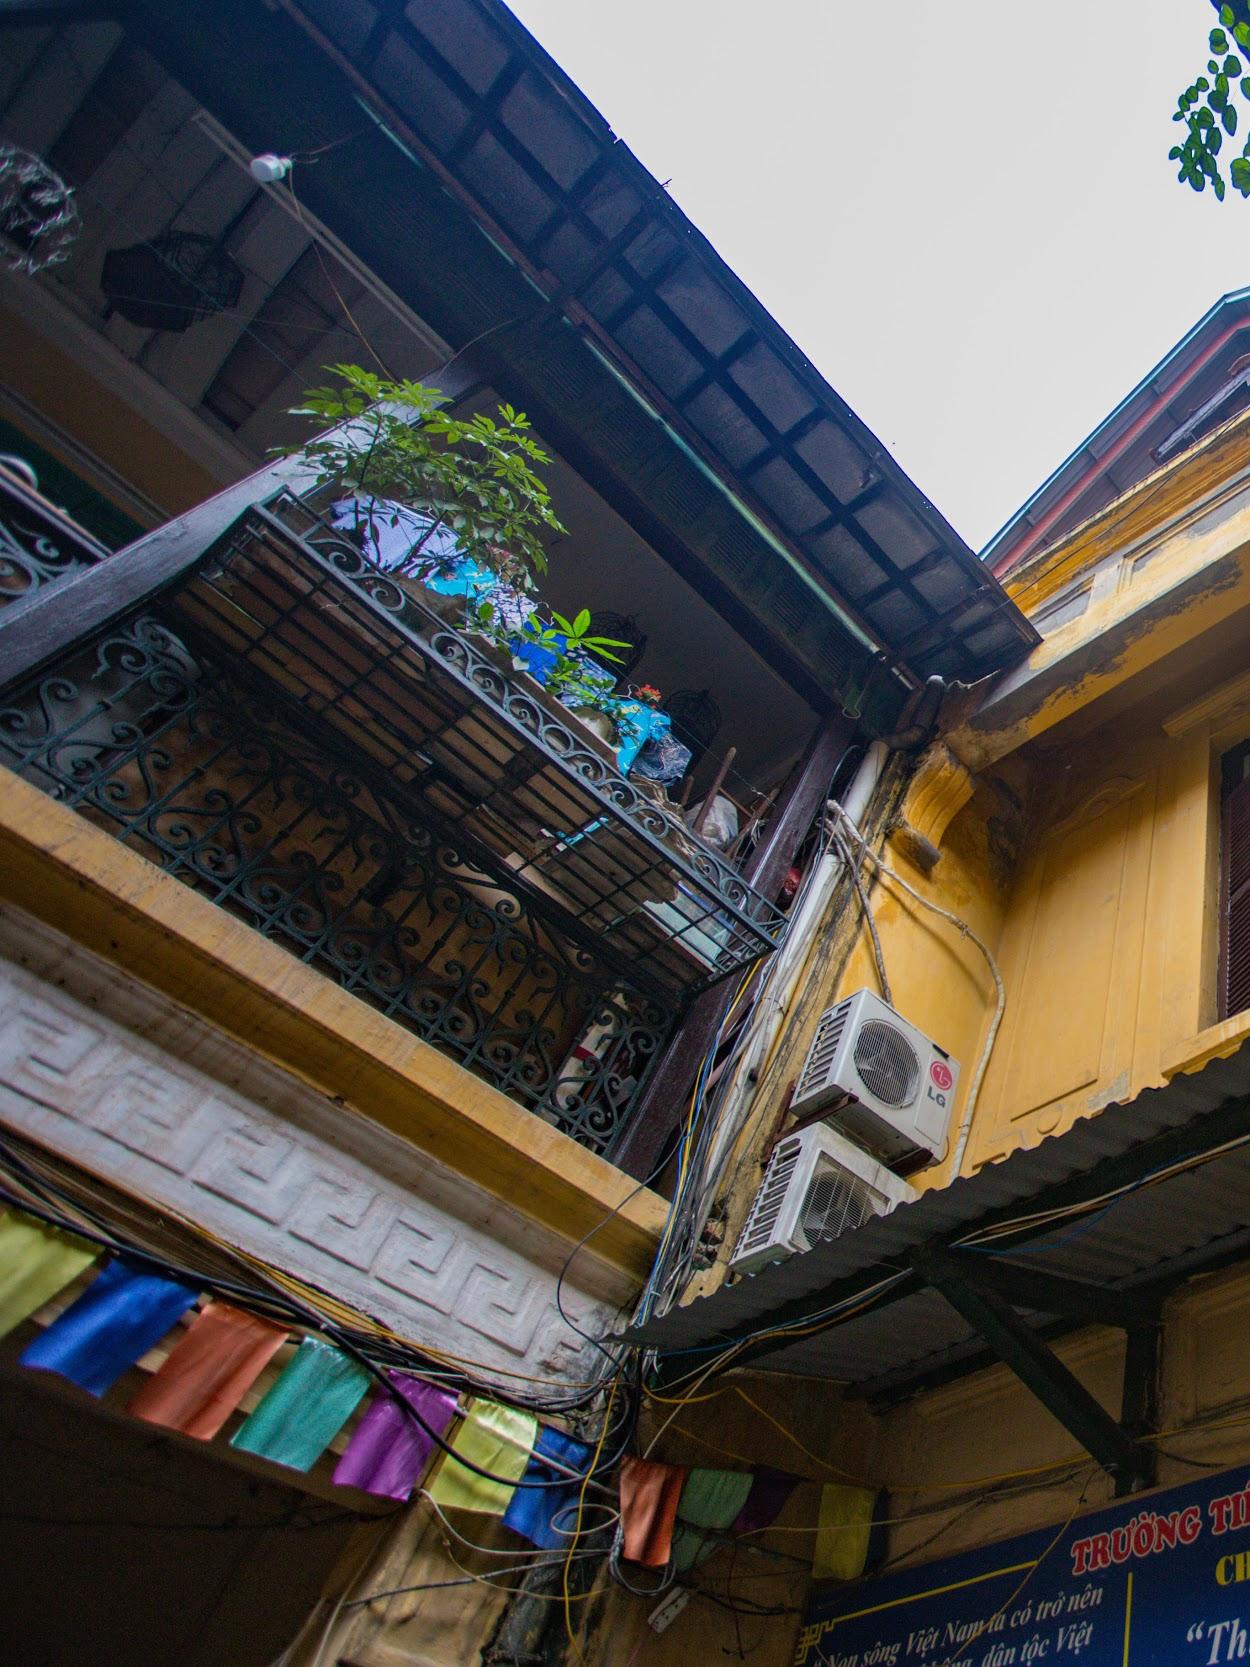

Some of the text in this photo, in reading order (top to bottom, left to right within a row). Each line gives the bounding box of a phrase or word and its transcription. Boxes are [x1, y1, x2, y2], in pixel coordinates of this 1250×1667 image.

[927, 1086, 946, 1108] LG
[1071, 1506, 1202, 1576] TRƯỜNG
[905, 1627, 939, 1658] Việt
[1010, 1600, 1033, 1628] có
[1067, 1583, 1103, 1612] nên
[981, 1620, 1094, 1667] dân tộc Việt
